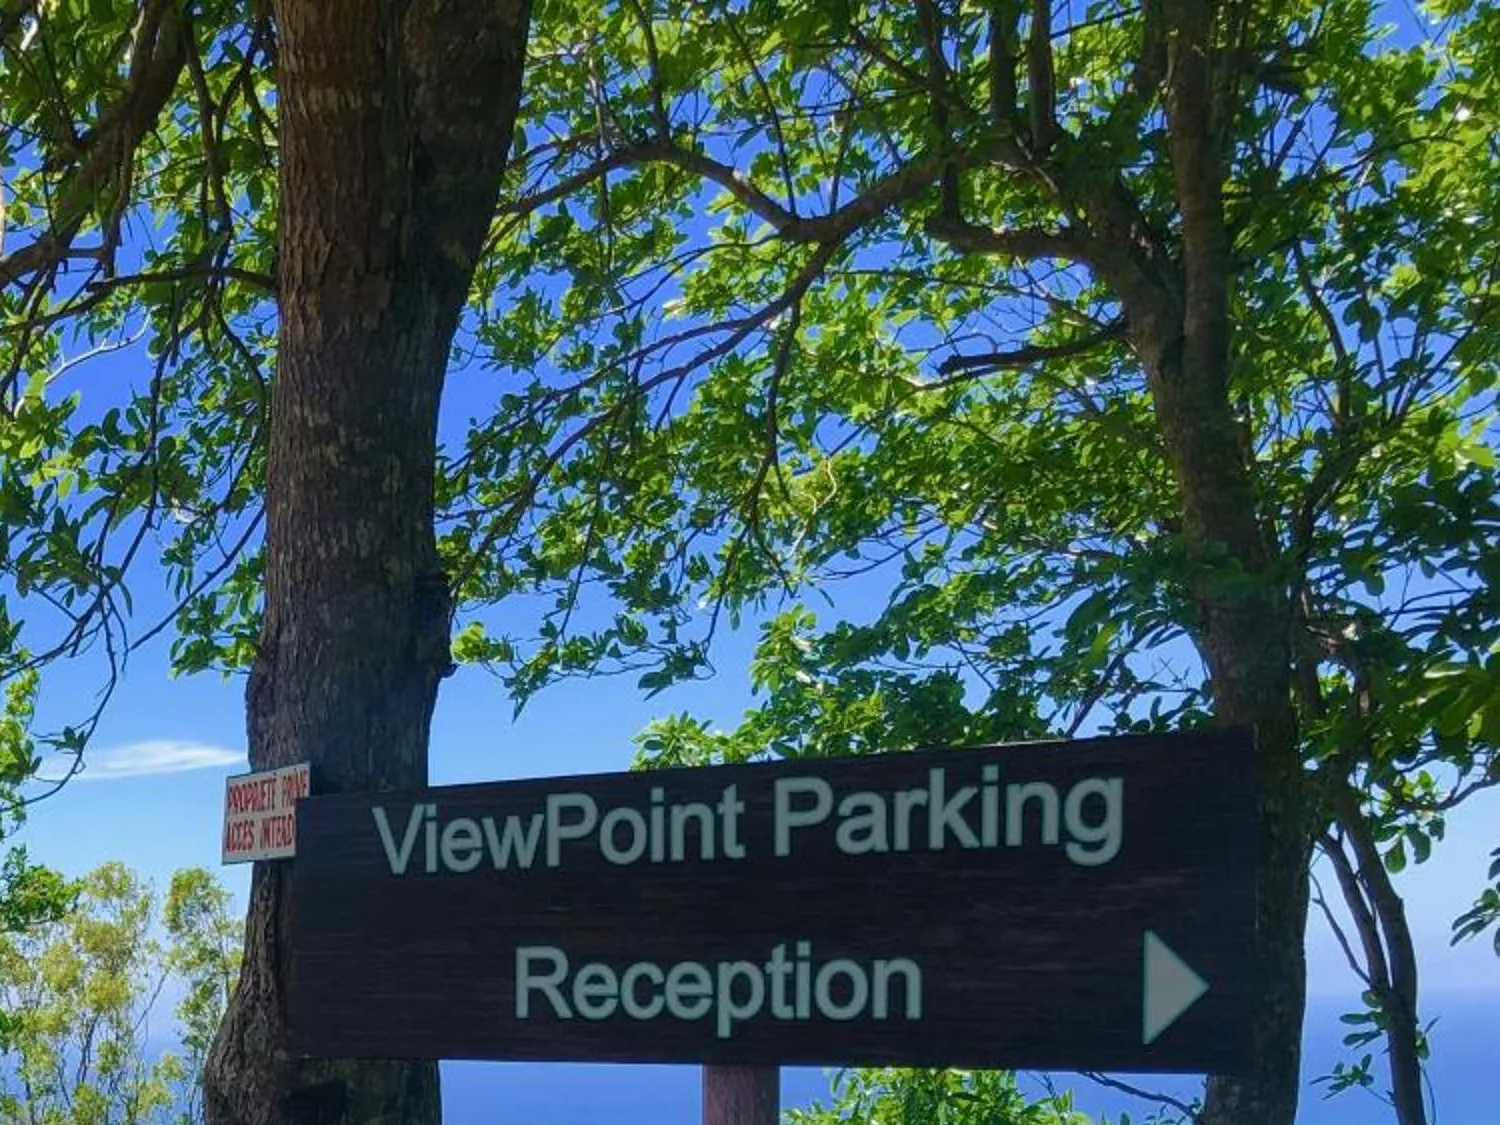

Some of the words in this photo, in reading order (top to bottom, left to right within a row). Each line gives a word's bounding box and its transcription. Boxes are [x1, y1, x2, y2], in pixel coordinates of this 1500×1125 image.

[373, 788, 745, 873] ViewPoint
[775, 765, 1123, 866] Parking
[515, 940, 922, 1038] Reception
